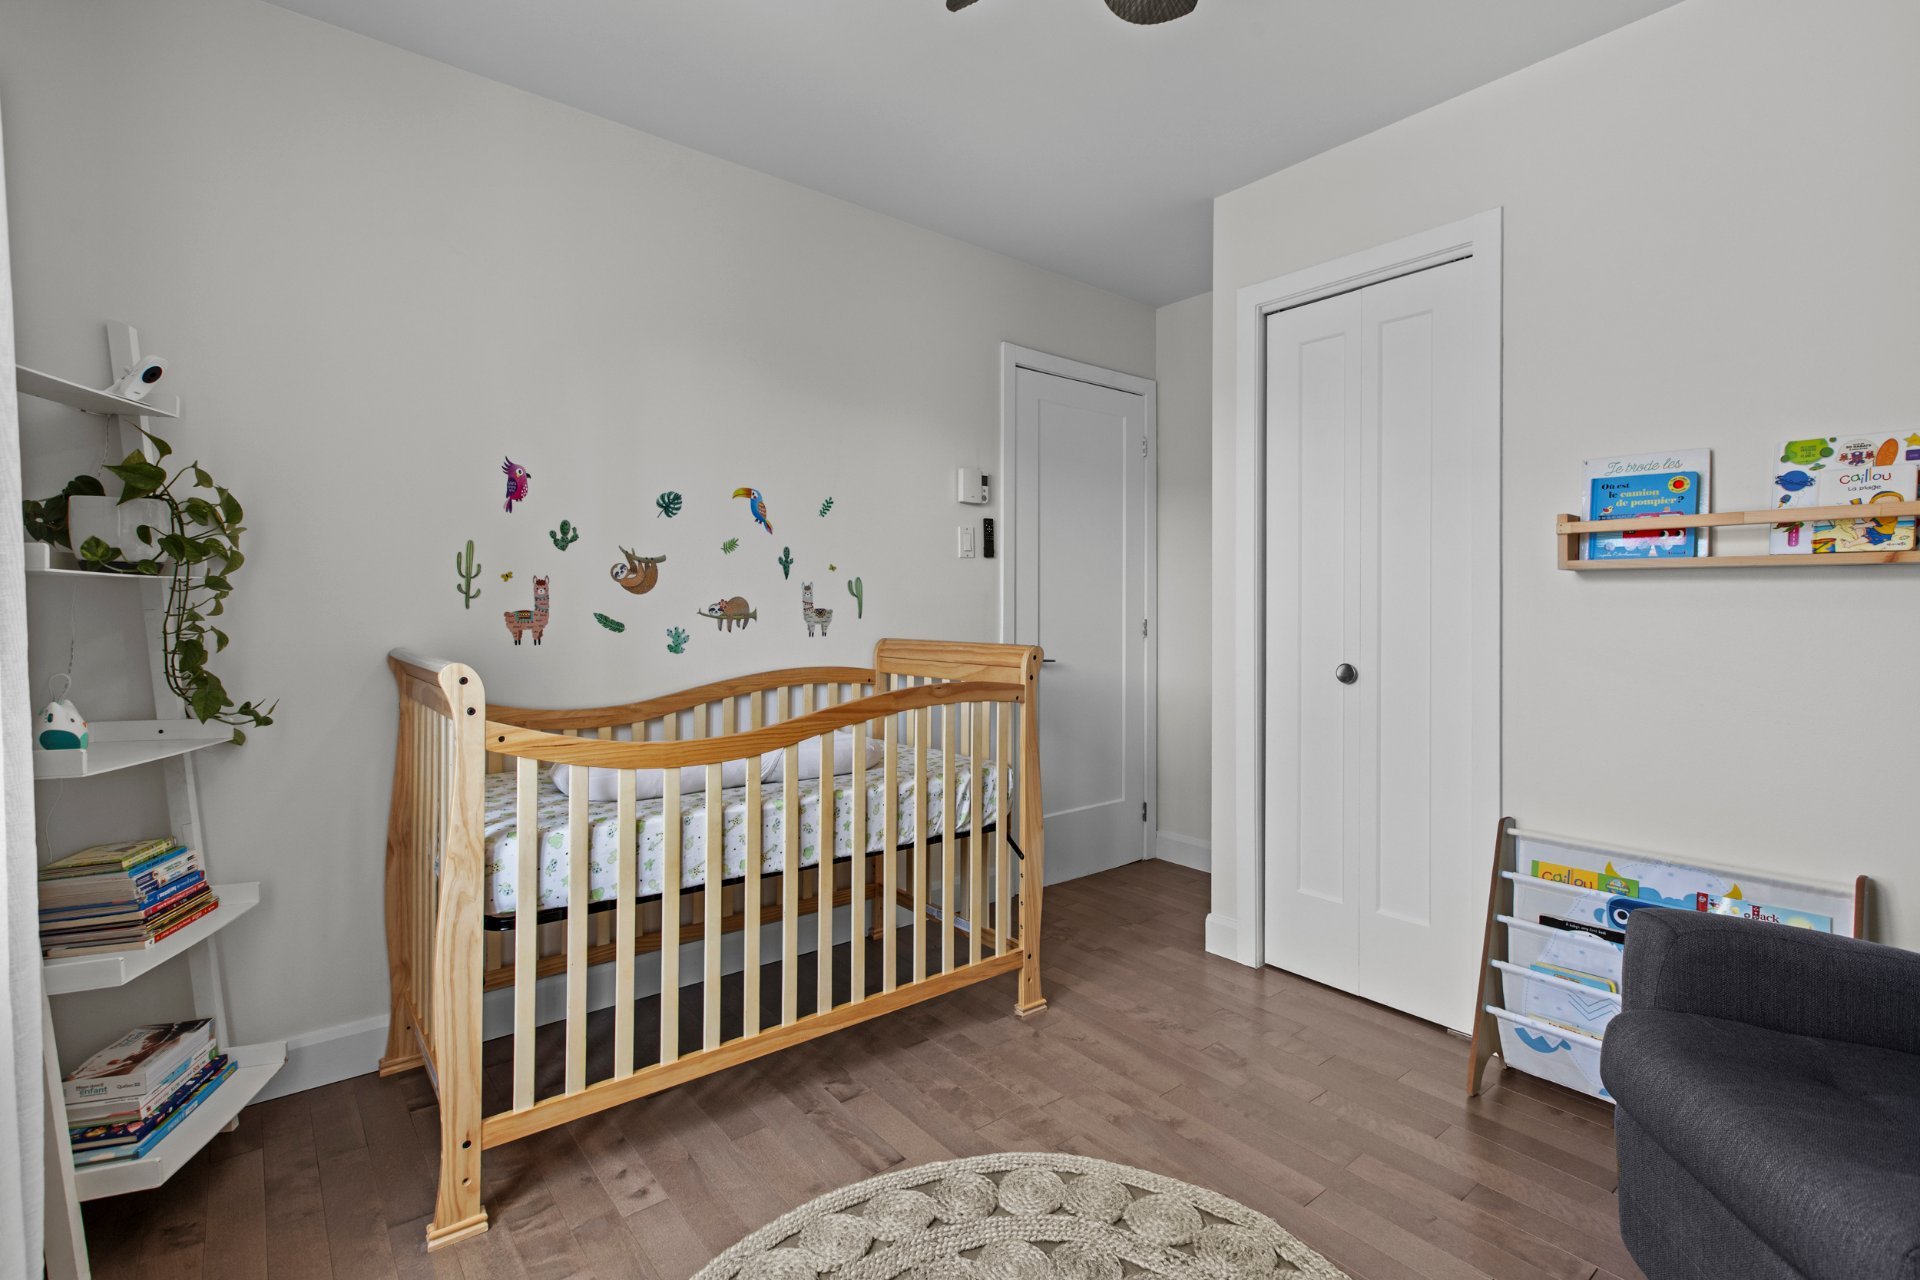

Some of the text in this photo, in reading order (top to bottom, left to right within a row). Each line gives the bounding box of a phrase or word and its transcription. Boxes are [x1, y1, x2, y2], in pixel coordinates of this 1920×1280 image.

[1604, 457, 1683, 476] Je brode les
[1609, 489, 1659, 499] le camion
[1616, 498, 1629, 507] de
[1631, 497, 1677, 507] pompier
